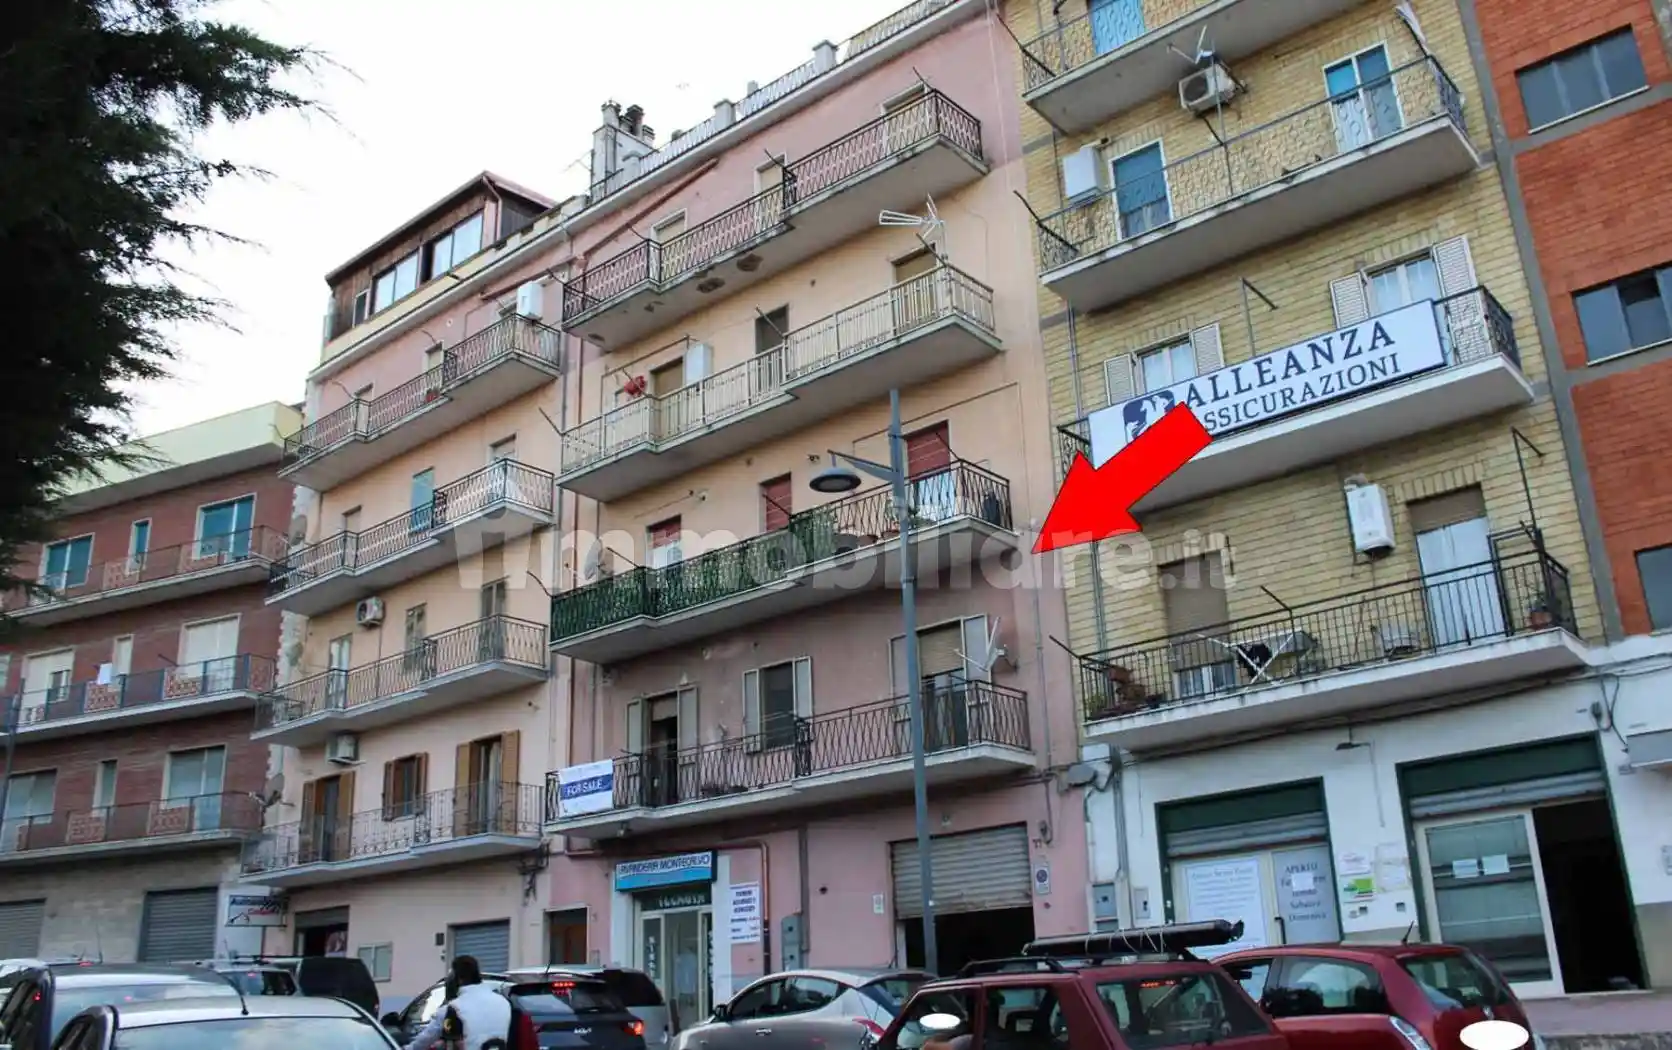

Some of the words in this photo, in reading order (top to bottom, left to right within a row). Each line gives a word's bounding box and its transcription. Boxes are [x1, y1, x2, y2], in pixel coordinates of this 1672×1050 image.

[1187, 320, 1395, 409] ALLEANZA
[1203, 352, 1402, 432] SSICURAZIONI
[567, 782, 581, 797] FOR
[583, 779, 602, 793] SALE
